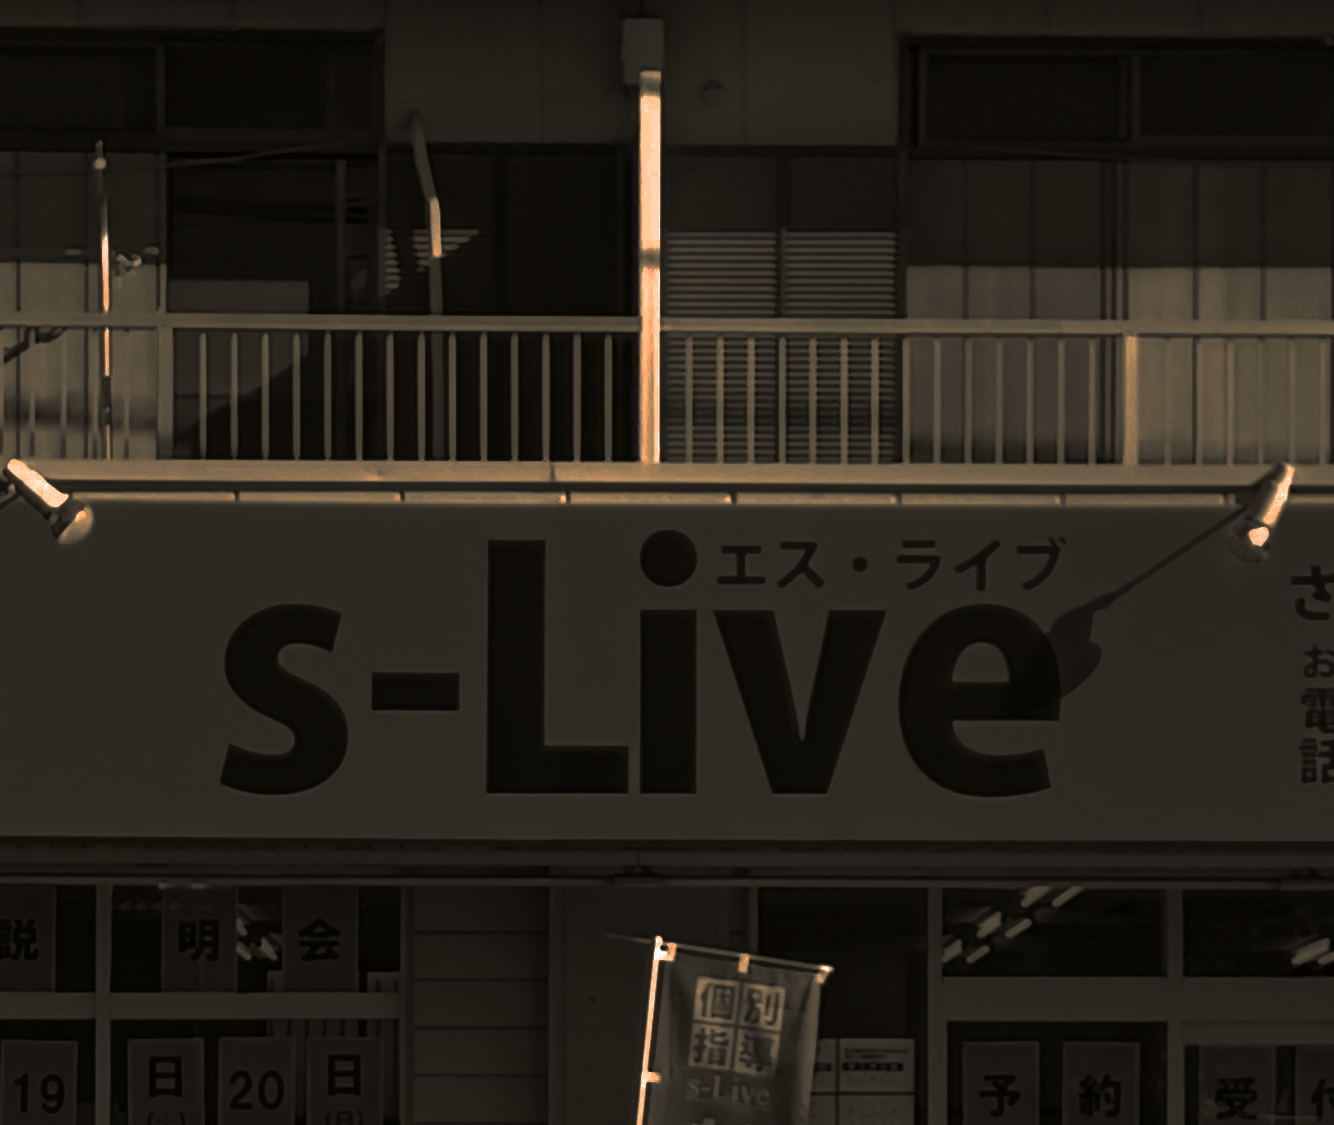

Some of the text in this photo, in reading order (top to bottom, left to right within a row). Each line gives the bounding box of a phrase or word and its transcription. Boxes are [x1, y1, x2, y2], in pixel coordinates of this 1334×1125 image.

[717, 536, 1065, 592] エス・ライブ
[220, 530, 1062, 797] s-Live
